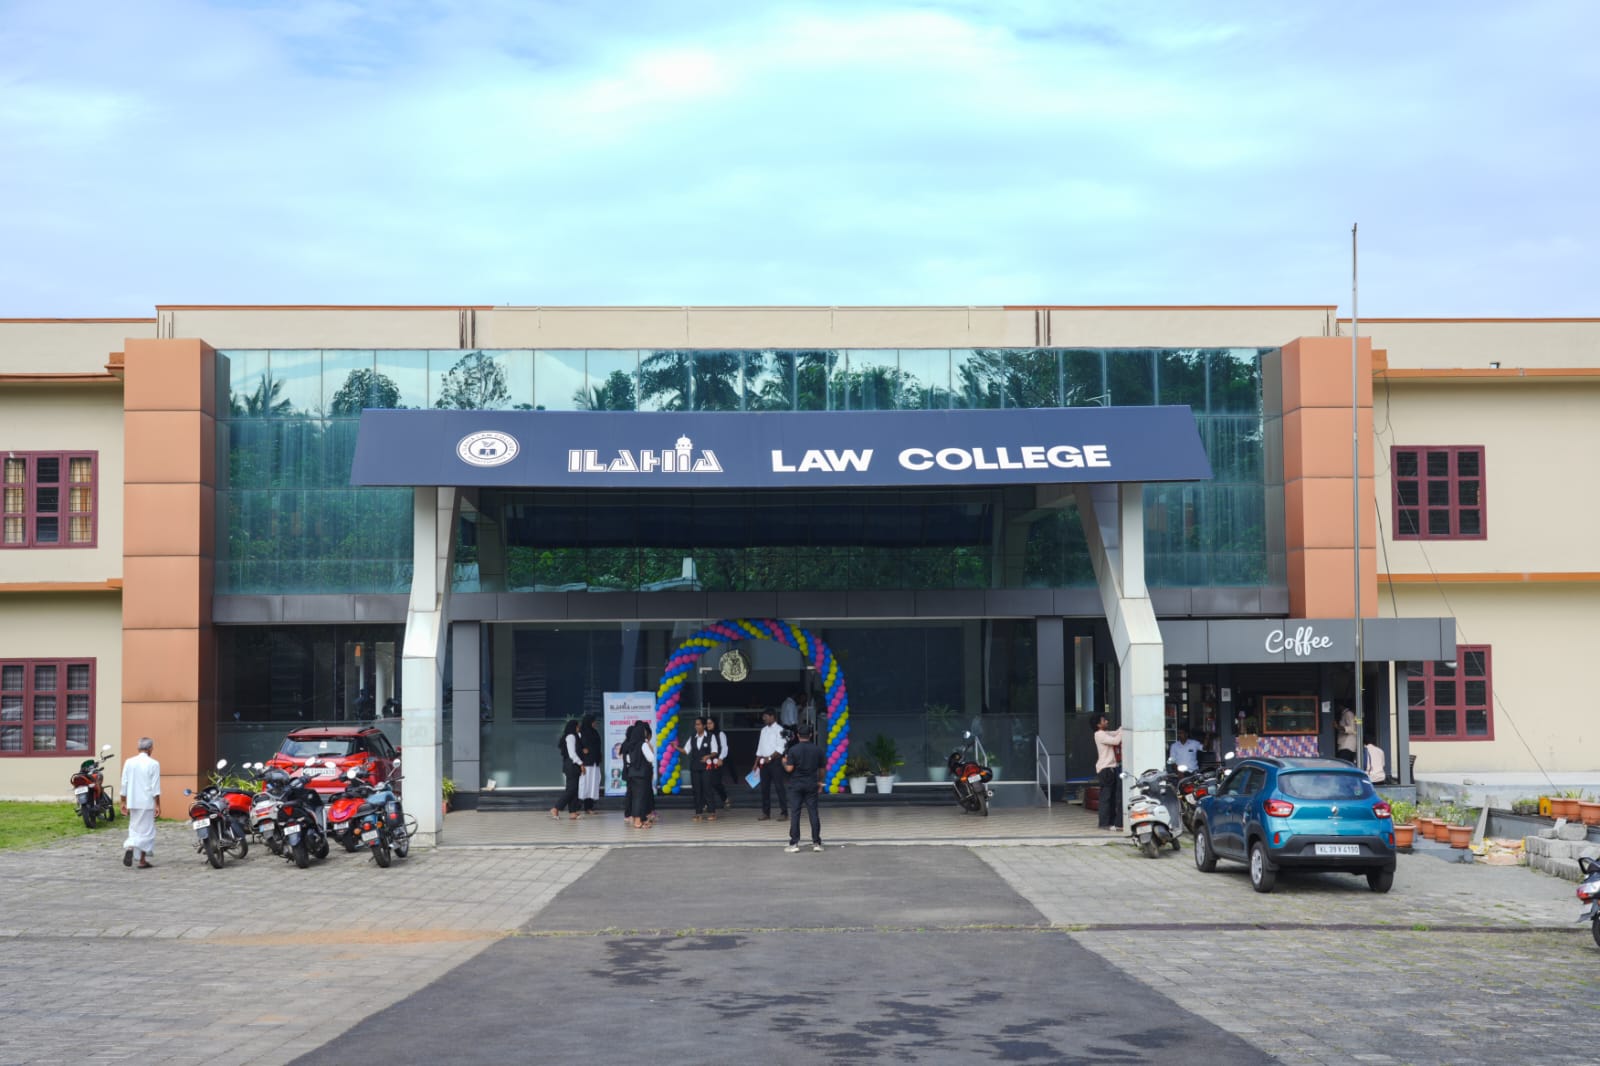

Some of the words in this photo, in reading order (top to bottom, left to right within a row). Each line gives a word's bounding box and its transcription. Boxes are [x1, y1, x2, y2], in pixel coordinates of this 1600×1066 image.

[568, 435, 724, 473] ILAHIA
[771, 448, 874, 473] LAW
[898, 444, 1112, 472] COLLEGE
[1265, 626, 1333, 656] Coffee
